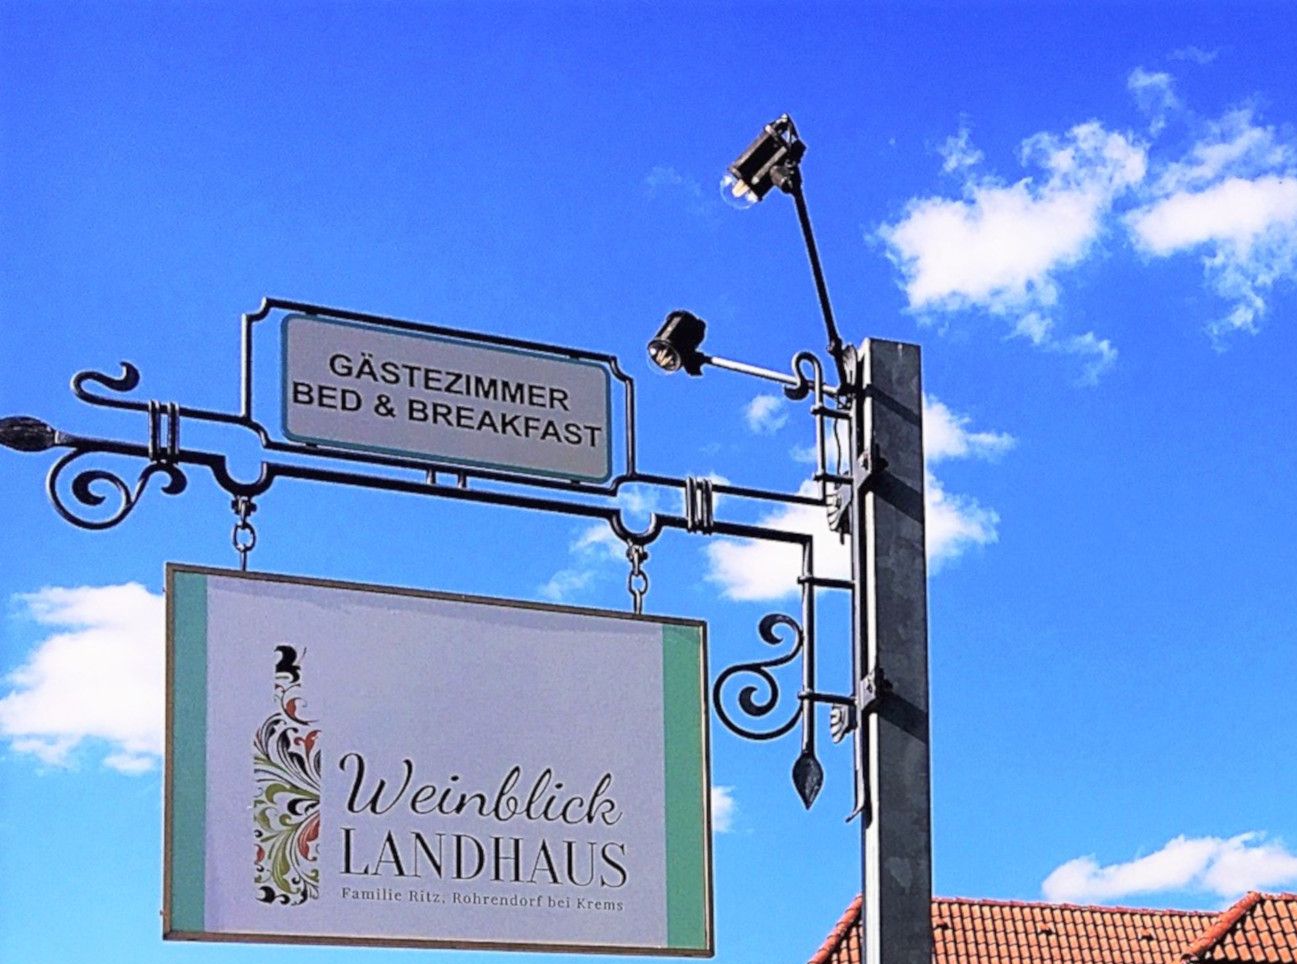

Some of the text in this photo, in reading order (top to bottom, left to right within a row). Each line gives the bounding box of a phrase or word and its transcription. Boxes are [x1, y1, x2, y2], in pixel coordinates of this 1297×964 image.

[329, 353, 569, 411] GÄSTEZIMMER
[292, 381, 602, 447] BED & BREAKFAST
[339, 753, 623, 825] Weinblick
[340, 827, 627, 888] LANDHAUS
[341, 887, 402, 902] Familie
[453, 892, 543, 907] Rohrendorf
[548, 896, 570, 908] bei
[577, 898, 624, 911] Krems
